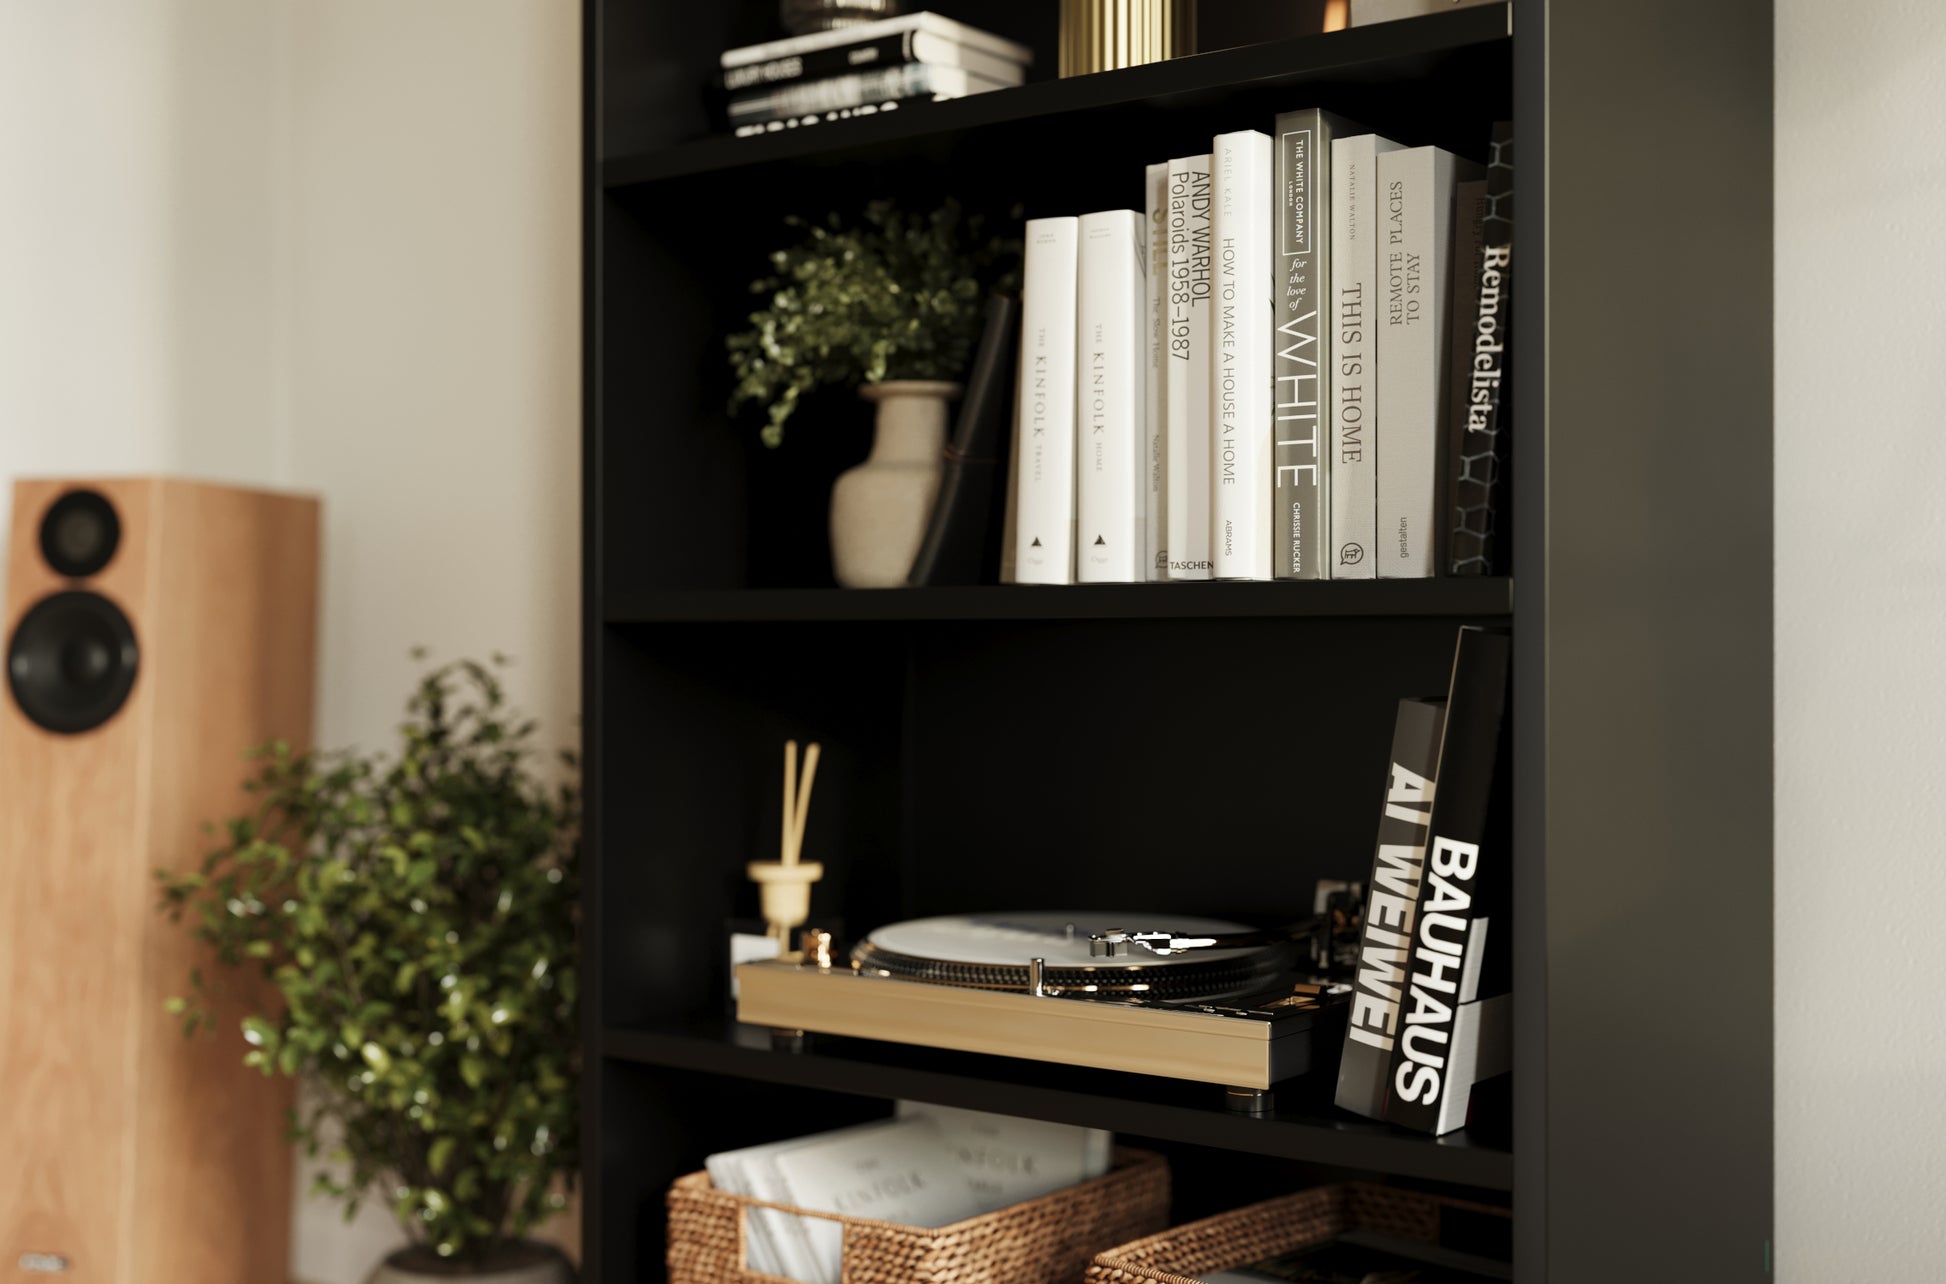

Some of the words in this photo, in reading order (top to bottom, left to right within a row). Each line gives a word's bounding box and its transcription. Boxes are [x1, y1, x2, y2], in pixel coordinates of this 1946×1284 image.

[1223, 148, 1232, 182] ARIEL
[1295, 140, 1304, 158] THE
[1191, 171, 1210, 220] ANDY
[1295, 161, 1304, 193] WHITE
[1171, 171, 1189, 254] Polaroids
[1223, 186, 1232, 217] KALE
[1295, 196, 1304, 244] COMPANY
[1389, 181, 1402, 244] PLACES
[1191, 226, 1210, 307] WARHOL
[1223, 238, 1235, 276] HOW
[1289, 258, 1307, 272] for
[1406, 253, 1420, 293] STAY
[1223, 280, 1235, 300] TO
[1287, 286, 1306, 296] love
[1290, 273, 1305, 283] the
[1389, 252, 1402, 326] REMOTE
[1289, 297, 1301, 311] of
[1342, 283, 1362, 343] THIS
[1406, 299, 1420, 325] TO
[1038, 328, 1046, 347] THE
[1223, 306, 1235, 348] MAKE
[1468, 244, 1511, 433] Remodelista
[1223, 353, 1235, 363] A
[1342, 353, 1362, 376] IS
[1033, 356, 1047, 437] KINFOLK
[1093, 352, 1104, 435] KINFOLK
[1223, 368, 1235, 419] HOUSE
[1277, 310, 1317, 488] WHITE
[1223, 423, 1235, 434] A
[1342, 385, 1362, 464] HOME
[1223, 440, 1235, 485] HOME
[1293, 502, 1301, 538] CHRISSIE
[1399, 517, 1409, 558] gestalten
[1170, 560, 1214, 570] TASCHEN
[1293, 540, 1301, 573] RUCKER
[1384, 761, 1436, 827] AI
[1349, 844, 1427, 1052] WEIWEI
[1394, 835, 1479, 1107] BAUHAUS
